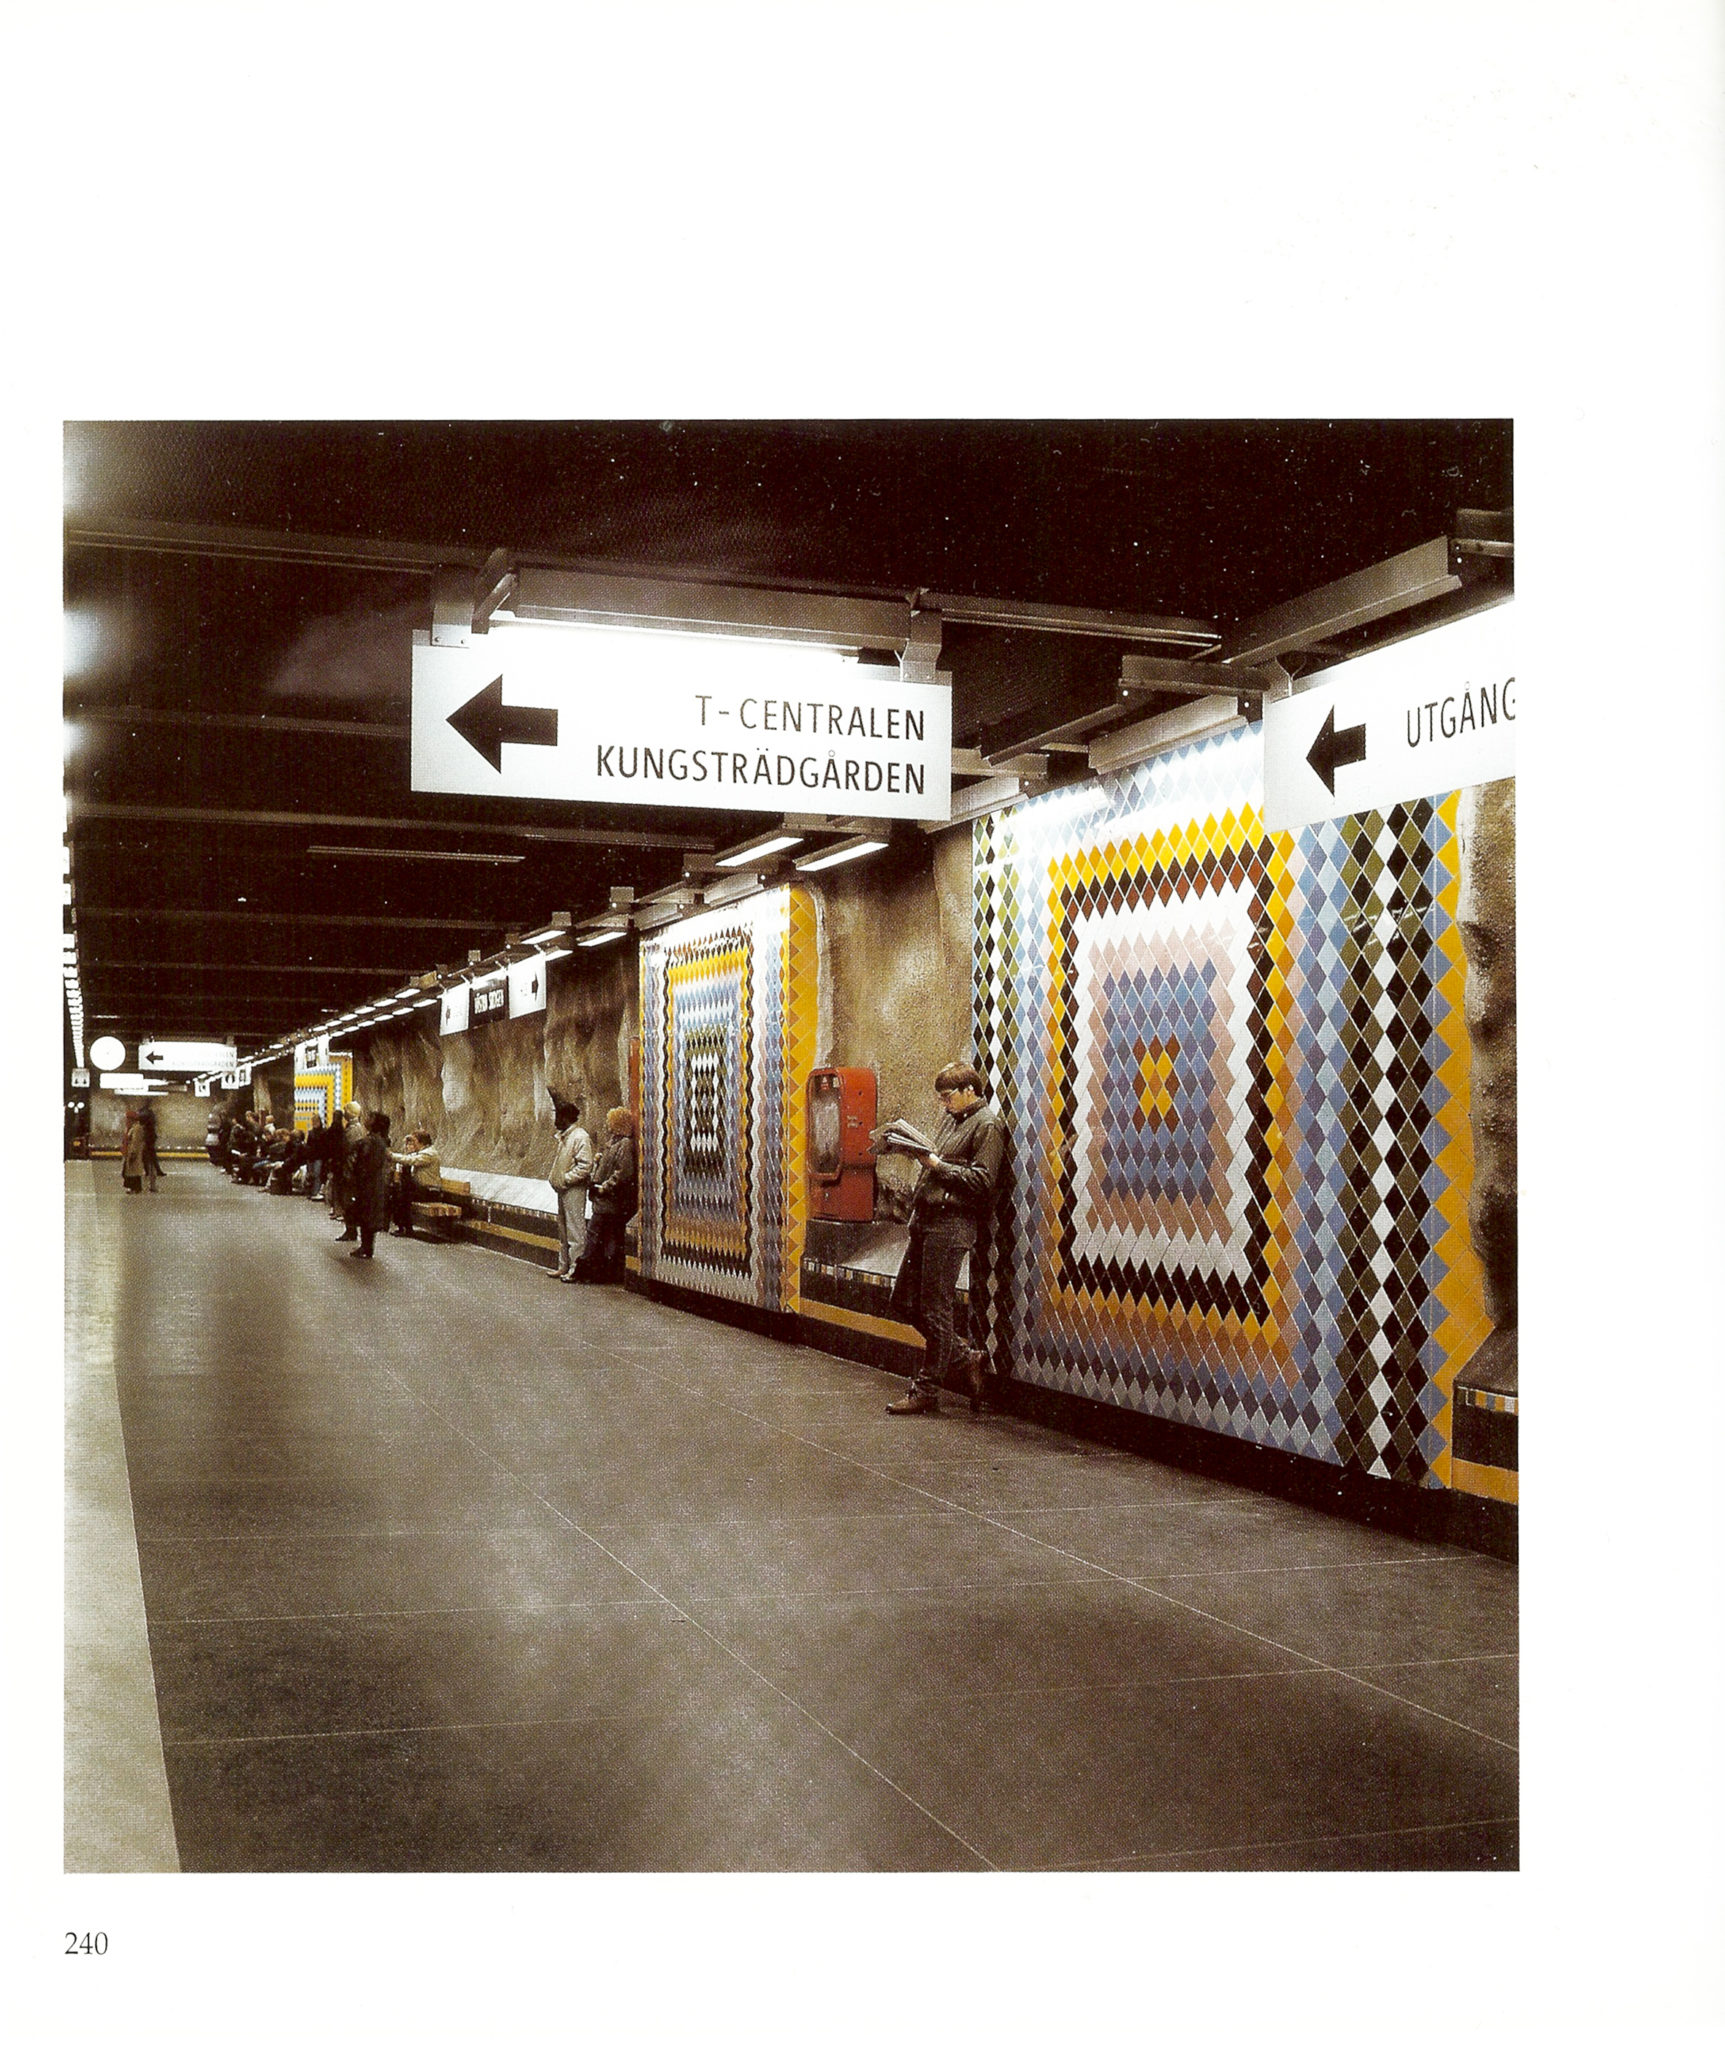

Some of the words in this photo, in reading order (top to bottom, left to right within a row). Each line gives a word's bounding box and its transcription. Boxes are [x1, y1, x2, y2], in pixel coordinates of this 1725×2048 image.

[695, 695, 925, 741] T-CENTRALEN
[596, 744, 925, 794] KUNGSTRÄDGÅRDEN
[64, 1931, 109, 1956] 240
